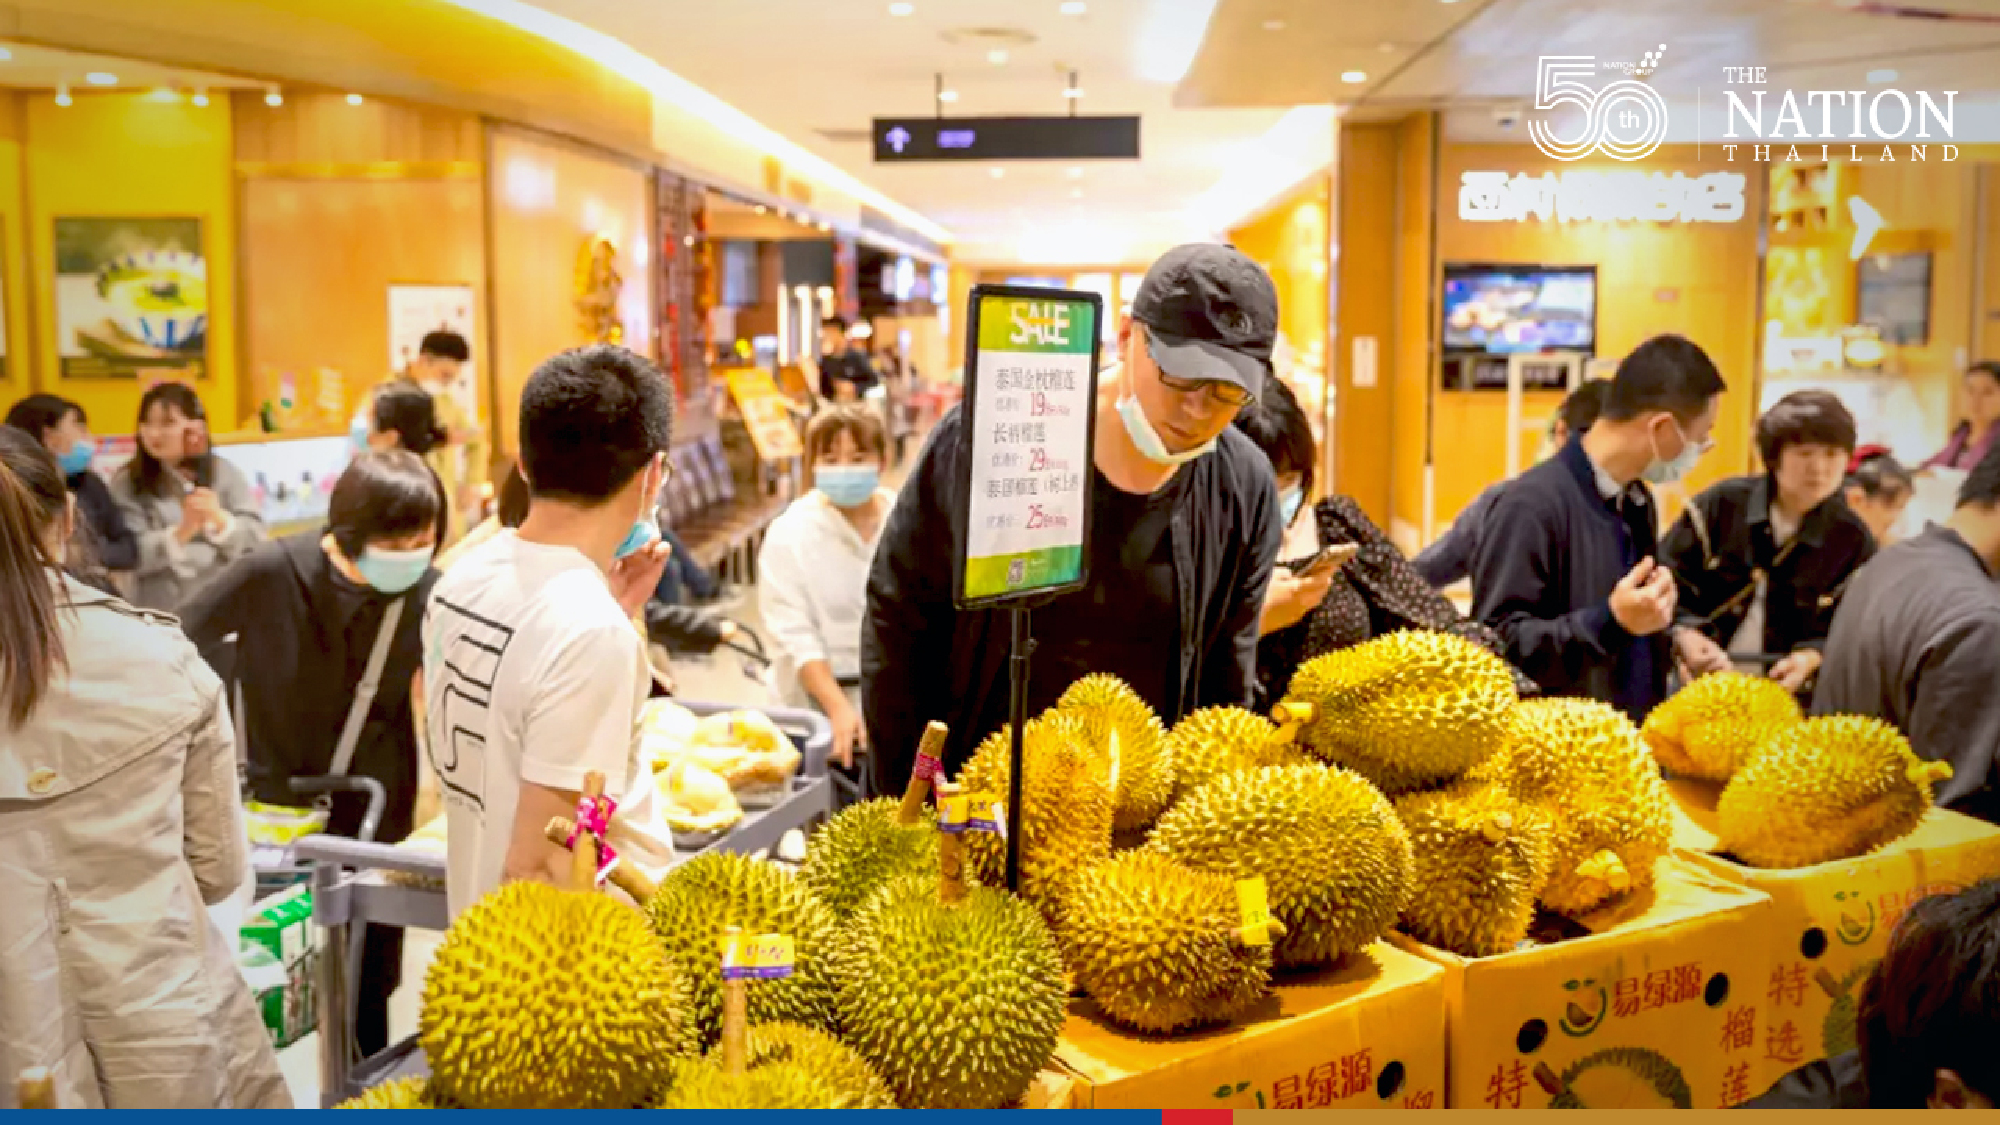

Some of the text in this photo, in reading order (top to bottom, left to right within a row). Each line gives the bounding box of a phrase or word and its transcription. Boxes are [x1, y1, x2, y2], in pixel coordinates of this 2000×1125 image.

[1009, 301, 1069, 346] SALE
[1030, 391, 1046, 417] 19
[1028, 447, 1046, 473] 29
[1025, 503, 1044, 529] 25
[1613, 961, 1703, 1019] 易绿源
[1763, 961, 1809, 1065] 特选
[1273, 1046, 1373, 1110] 易绿源
[1719, 1004, 1757, 1109] 榴莲
[1484, 1058, 1531, 1110] 特
